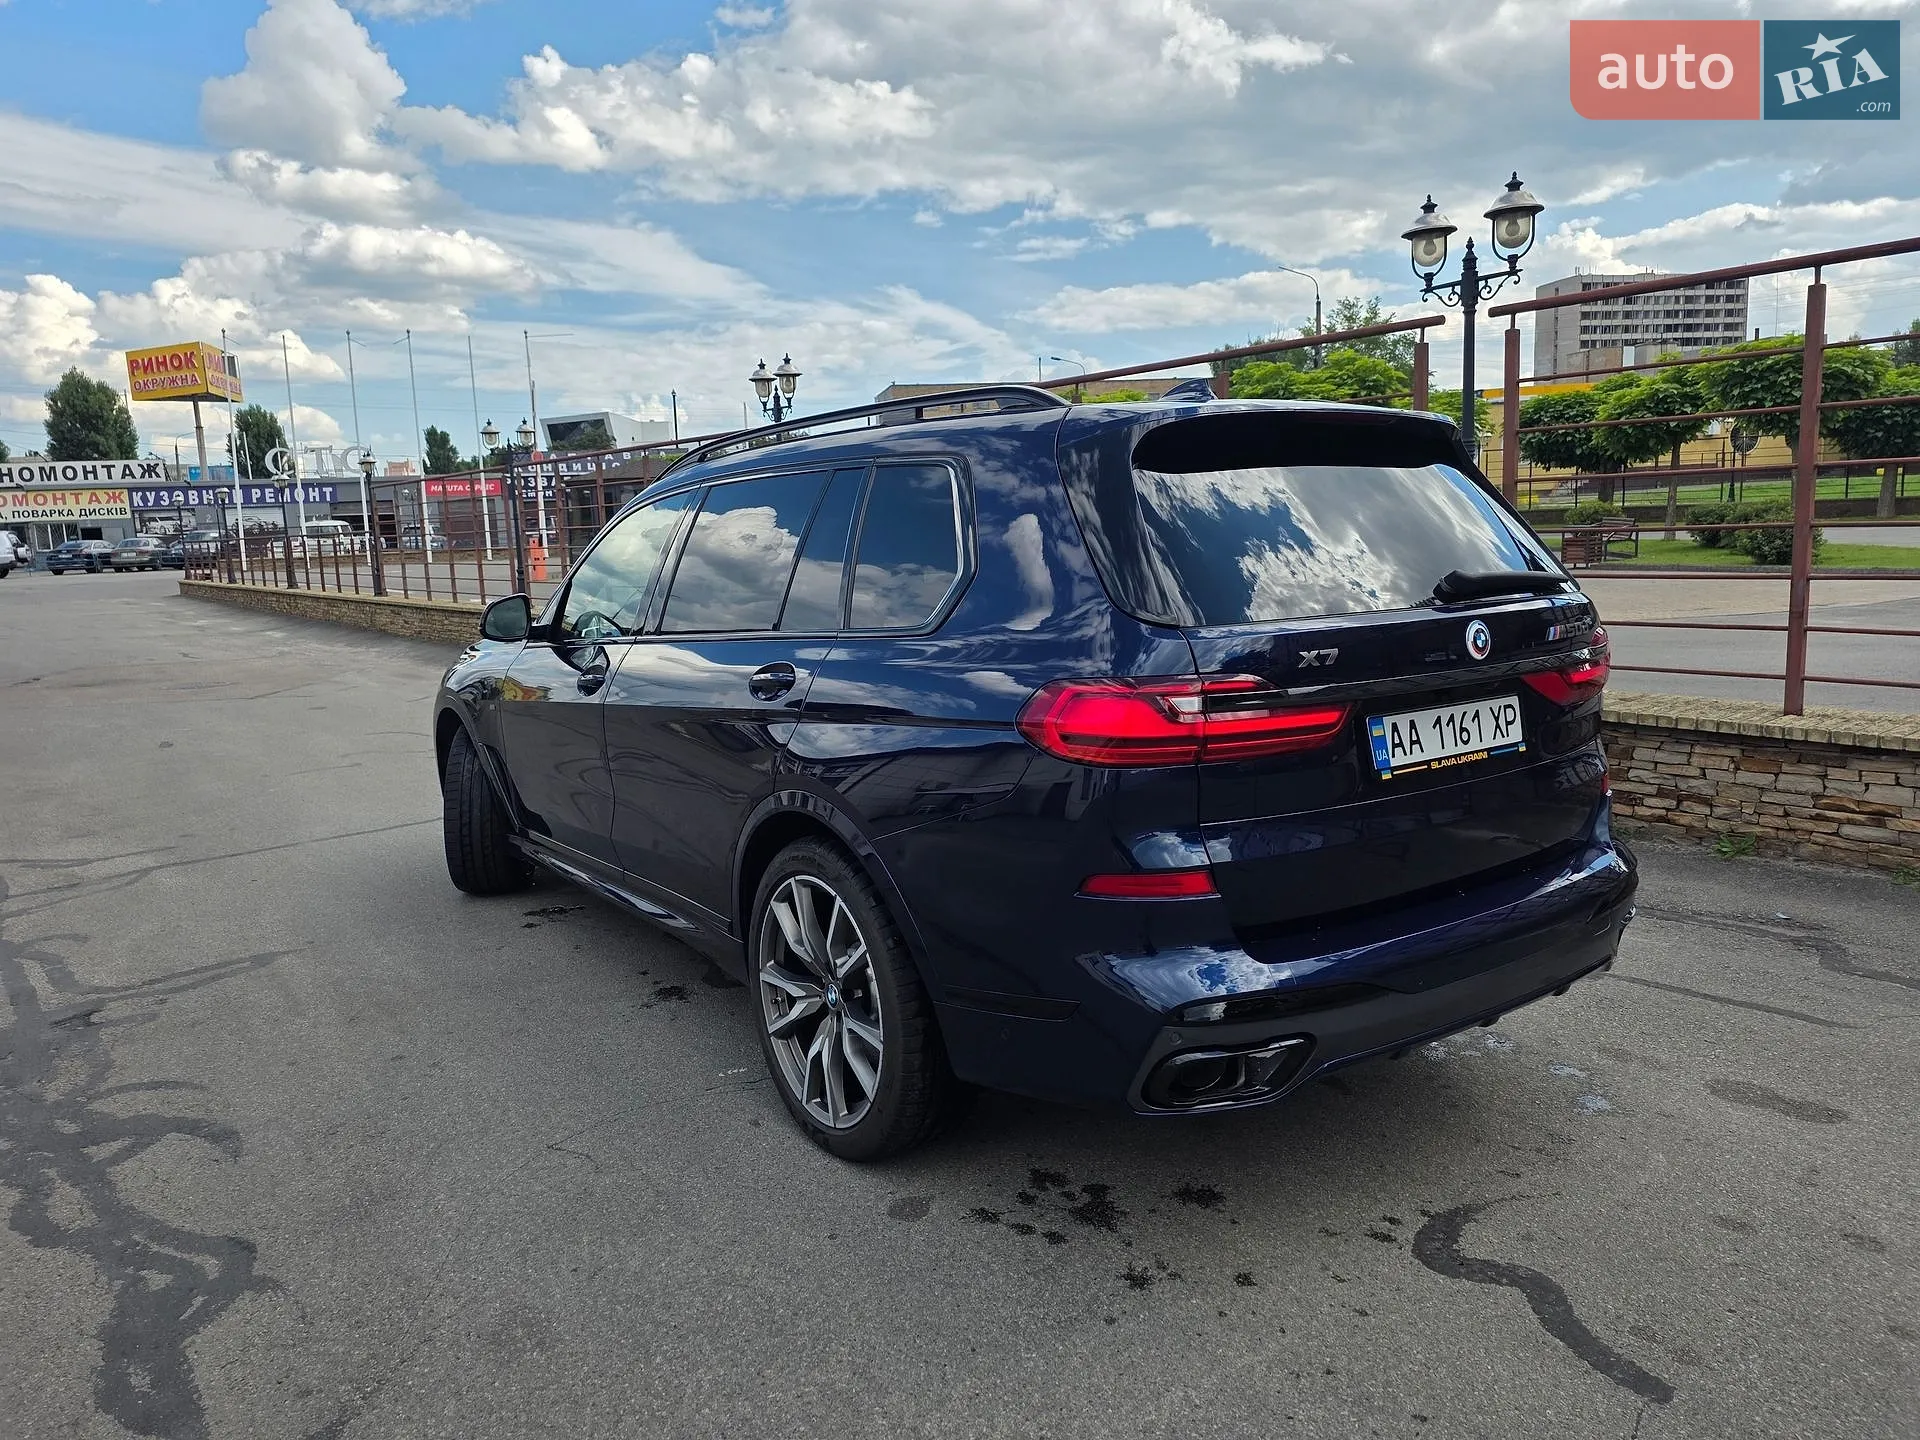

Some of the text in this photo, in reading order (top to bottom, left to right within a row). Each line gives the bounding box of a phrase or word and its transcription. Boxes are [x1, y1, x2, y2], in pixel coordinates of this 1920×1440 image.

[129, 351, 198, 377] РИНОК
[133, 372, 201, 392] ОКРУЖНА
[0, 463, 161, 483] НОМОНТАЖ
[12, 507, 75, 519] ПОВАРКА
[79, 507, 128, 518] ДИСКІВ
[1298, 648, 1339, 668] X7
[1391, 703, 1517, 759] AA 1161 XP
[1375, 749, 1389, 761] UA
[1431, 751, 1488, 769] SLAVA UKRAINI
